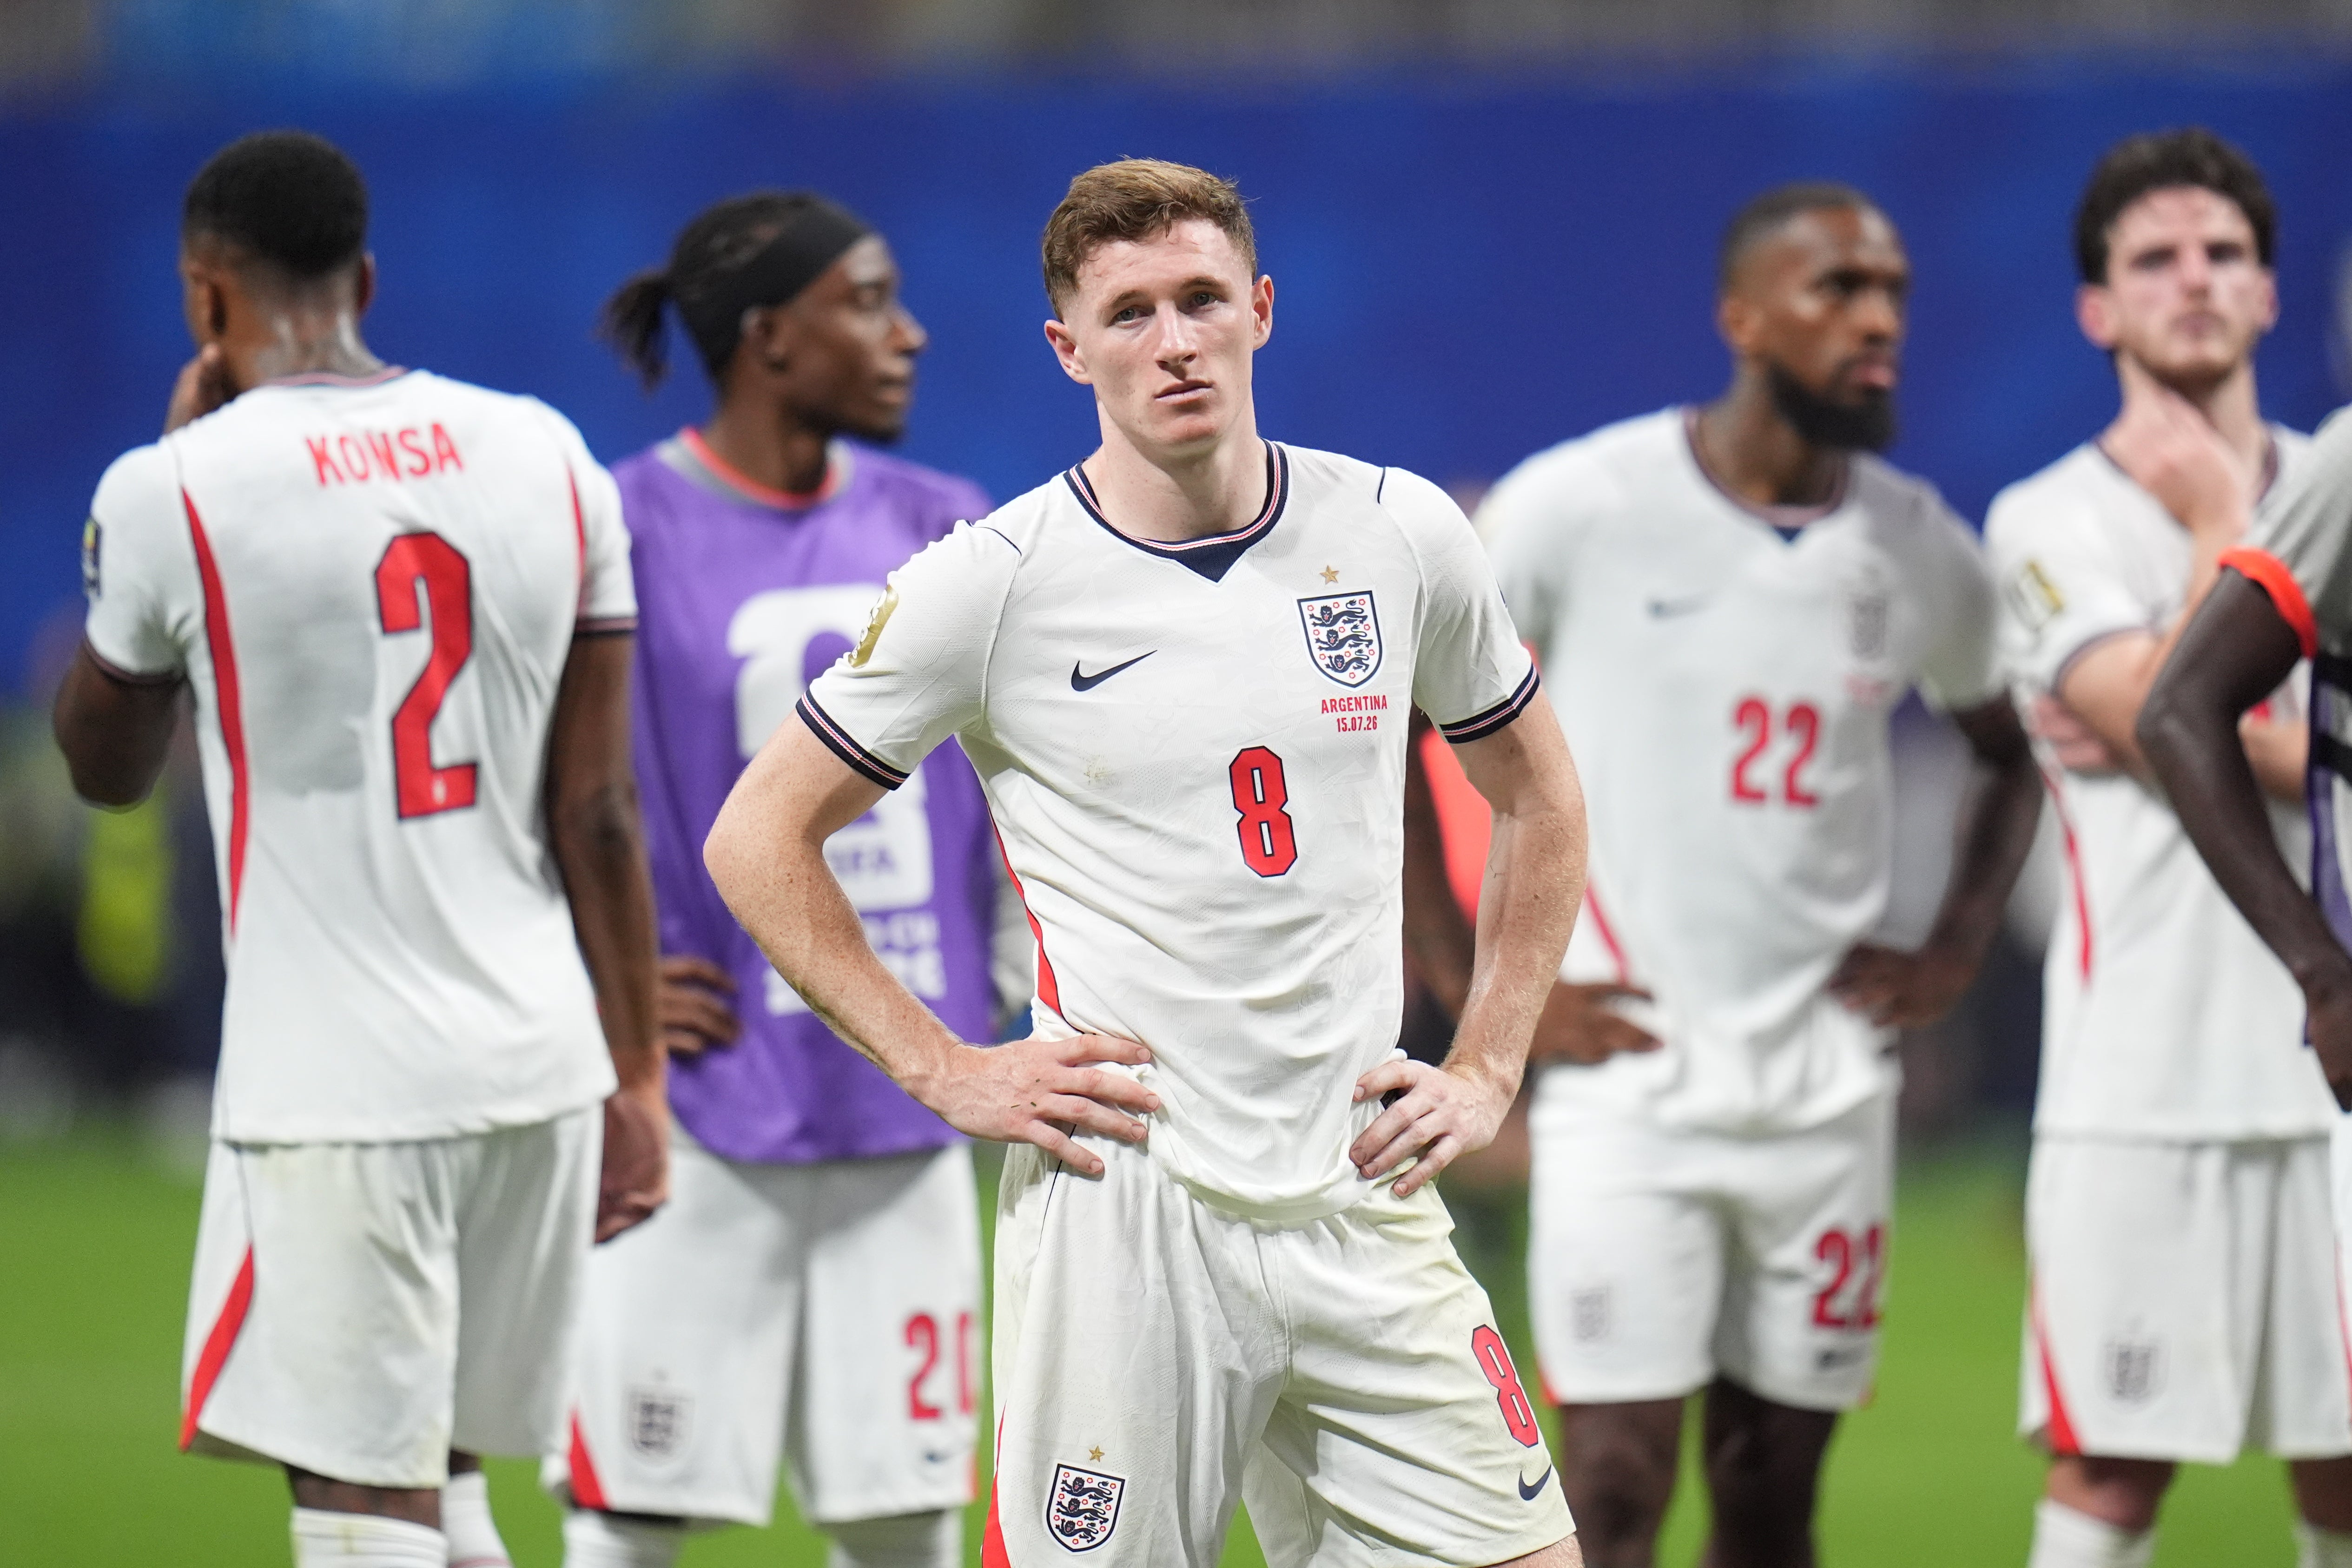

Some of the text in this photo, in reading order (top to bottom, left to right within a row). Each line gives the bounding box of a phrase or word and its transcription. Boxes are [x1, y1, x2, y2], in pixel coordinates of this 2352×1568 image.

[305, 422, 464, 485] KONSA
[374, 531, 479, 821] 2
[1321, 695, 1387, 714] ARGENTINA
[1336, 715, 1377, 732] 15.07.26
[1730, 696, 1821, 807] 22
[1229, 745, 1298, 878] 8
[1471, 1324, 1539, 1448] 8
